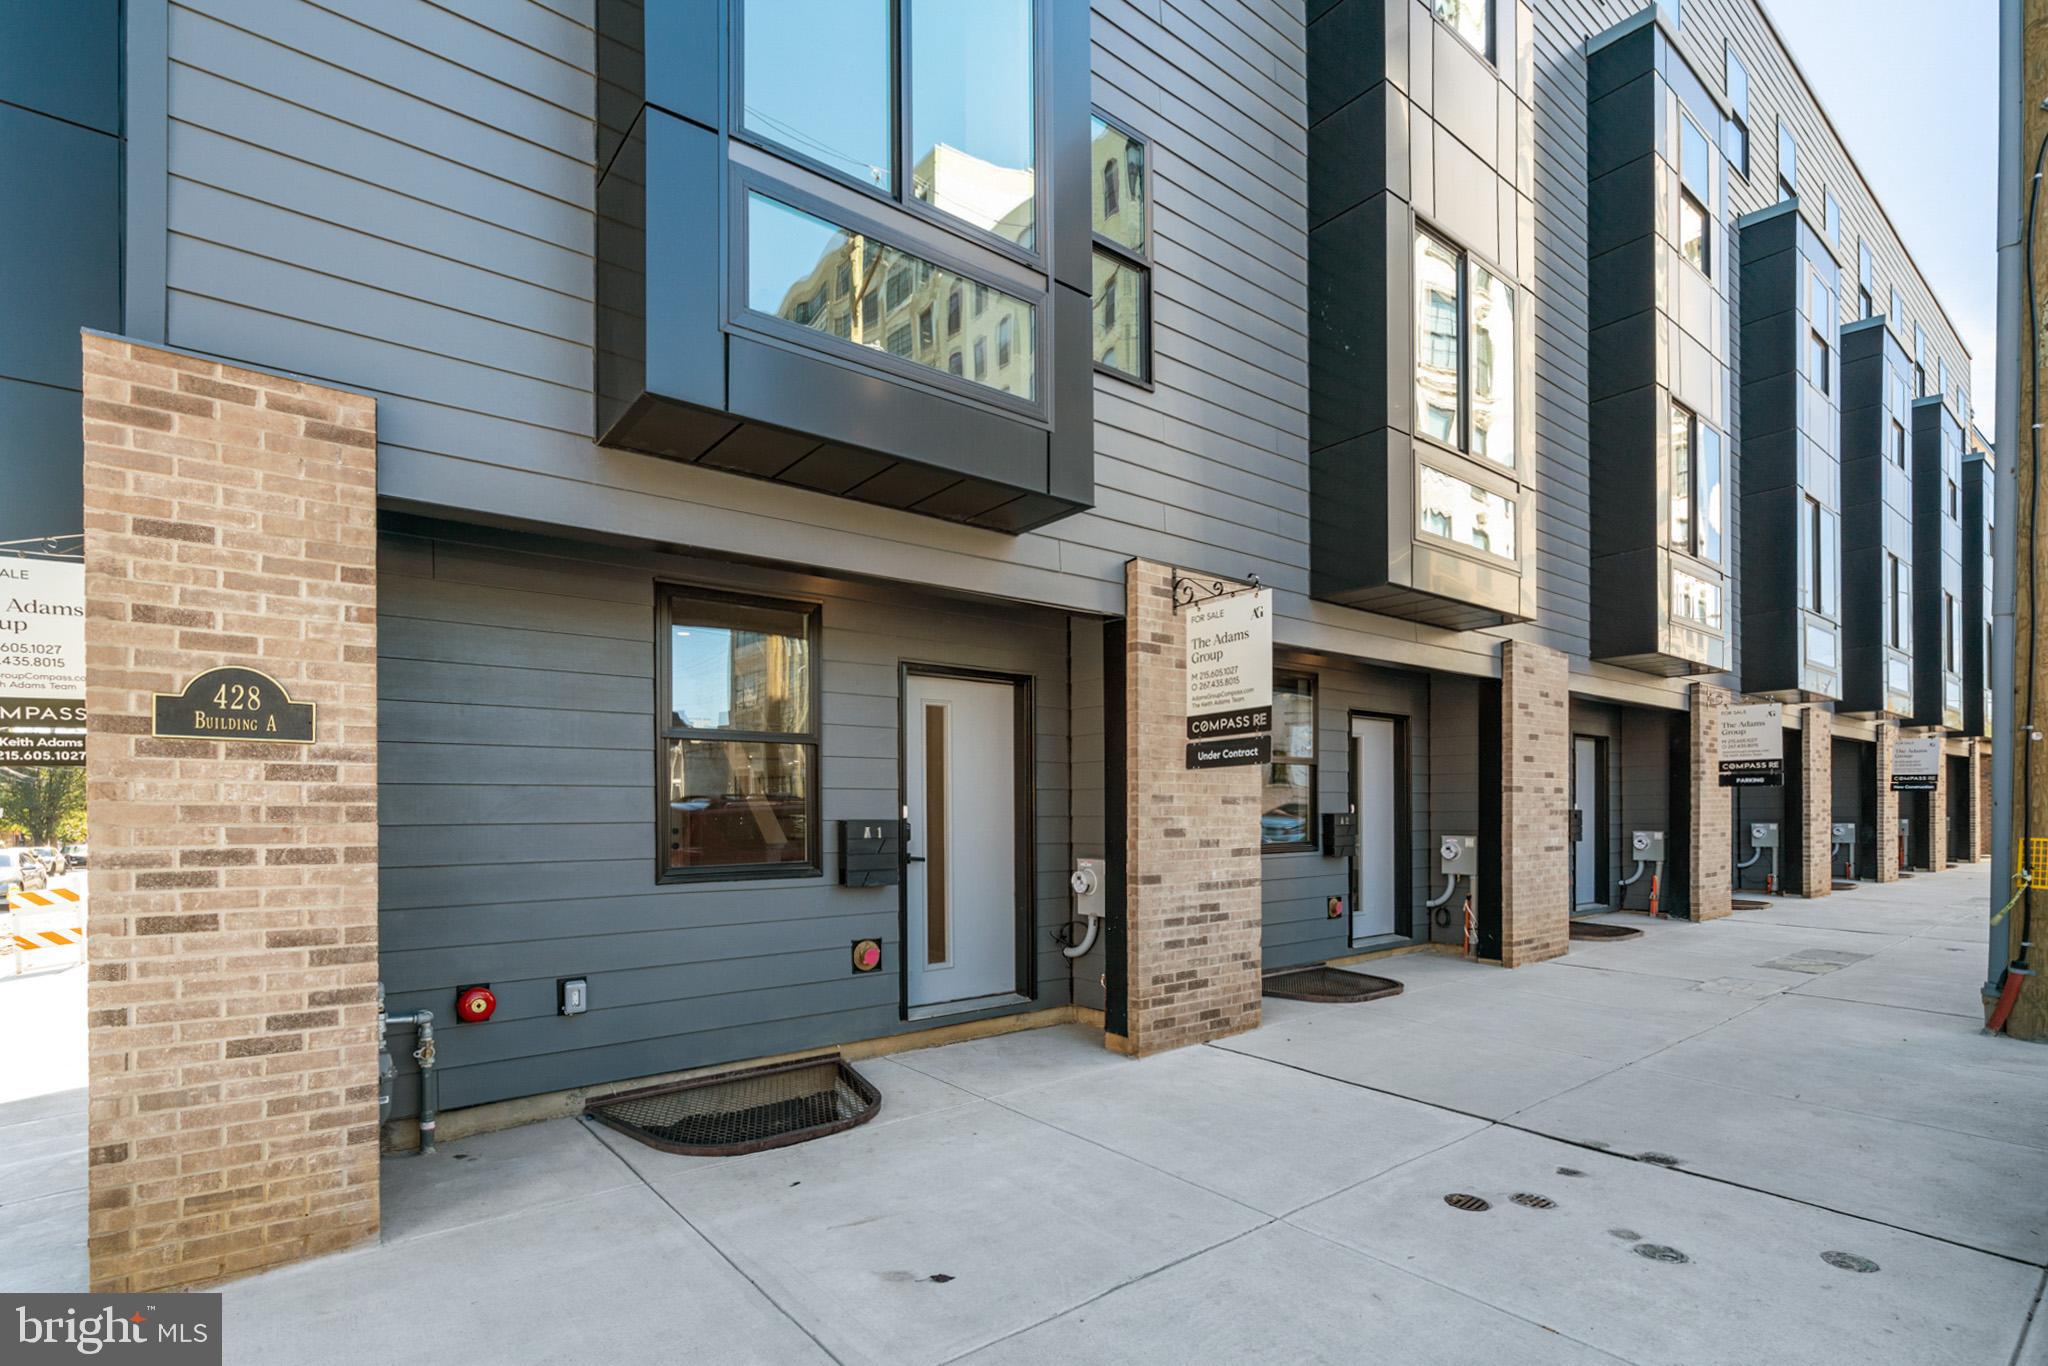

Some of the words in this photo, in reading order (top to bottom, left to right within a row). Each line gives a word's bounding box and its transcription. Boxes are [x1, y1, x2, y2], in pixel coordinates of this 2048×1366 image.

[6, 598, 84, 617] Adams
[1191, 614, 1205, 624] FOR
[1206, 609, 1225, 620] SALE
[1191, 637, 1211, 650] The
[1213, 630, 1250, 646] Adams
[1191, 650, 1224, 664] Group
[49, 682, 77, 690] Team
[213, 683, 261, 711] 428
[266, 714, 277, 732] A
[1191, 715, 1250, 733] COMPASS
[1253, 713, 1267, 726] RE
[1739, 720, 1766, 728] Adams
[0, 737, 34, 747] Keith
[36, 737, 84, 748] Adams
[0, 750, 87, 761] 215.605.1027
[1198, 751, 1221, 761] Under
[1222, 747, 1259, 759] Contract
[1722, 761, 1767, 770] COMPASS
